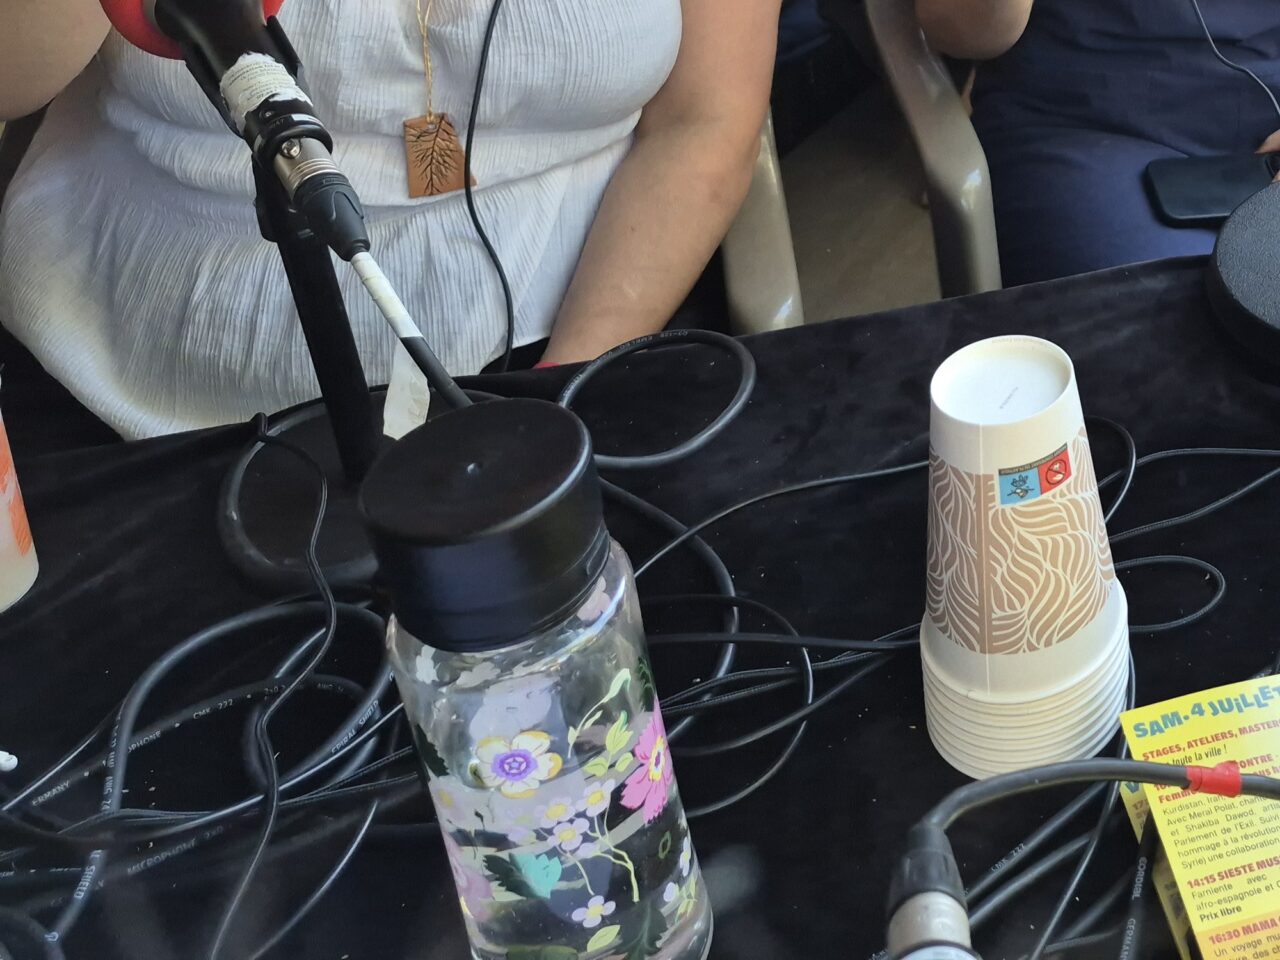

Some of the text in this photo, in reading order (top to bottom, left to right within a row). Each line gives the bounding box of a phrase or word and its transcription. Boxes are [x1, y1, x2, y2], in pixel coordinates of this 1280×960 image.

[1132, 710, 1190, 737] SAM.
[1190, 702, 1204, 716] 4
[1142, 743, 1185, 761] STAGES,
[1186, 730, 1237, 748] ATELIERS,
[1194, 752, 1202, 760] la
[1204, 746, 1221, 758] ville
[29, 780, 73, 806] ERMANY
[1166, 815, 1186, 825] Avec
[1188, 807, 1212, 819] Meral
[1170, 828, 1179, 836] et
[1185, 818, 1219, 832] Shakiba
[1173, 830, 1217, 847] Parlement
[1220, 826, 1231, 834] de
[1258, 813, 1279, 824] Suivi
[1177, 841, 1220, 857] hommage
[1223, 838, 1229, 846] à
[1240, 825, 1280, 840] révolution
[1207, 852, 1223, 862] une
[1225, 837, 1279, 856] collaboration
[1187, 874, 1216, 888] 14:15
[1217, 863, 1254, 880] SIESTE
[1191, 883, 1232, 898] Farniente
[1246, 873, 1267, 884] avec
[1196, 887, 1261, 910] afro-espagnole
[1264, 882, 1274, 891] et
[1199, 905, 1241, 922] Prix libre
[1208, 928, 1240, 944] 16:30
[1241, 918, 1277, 935] MAMA
[1213, 948, 1227, 957] Un
[1231, 938, 1262, 952] voyage
[1252, 949, 1269, 958] des
